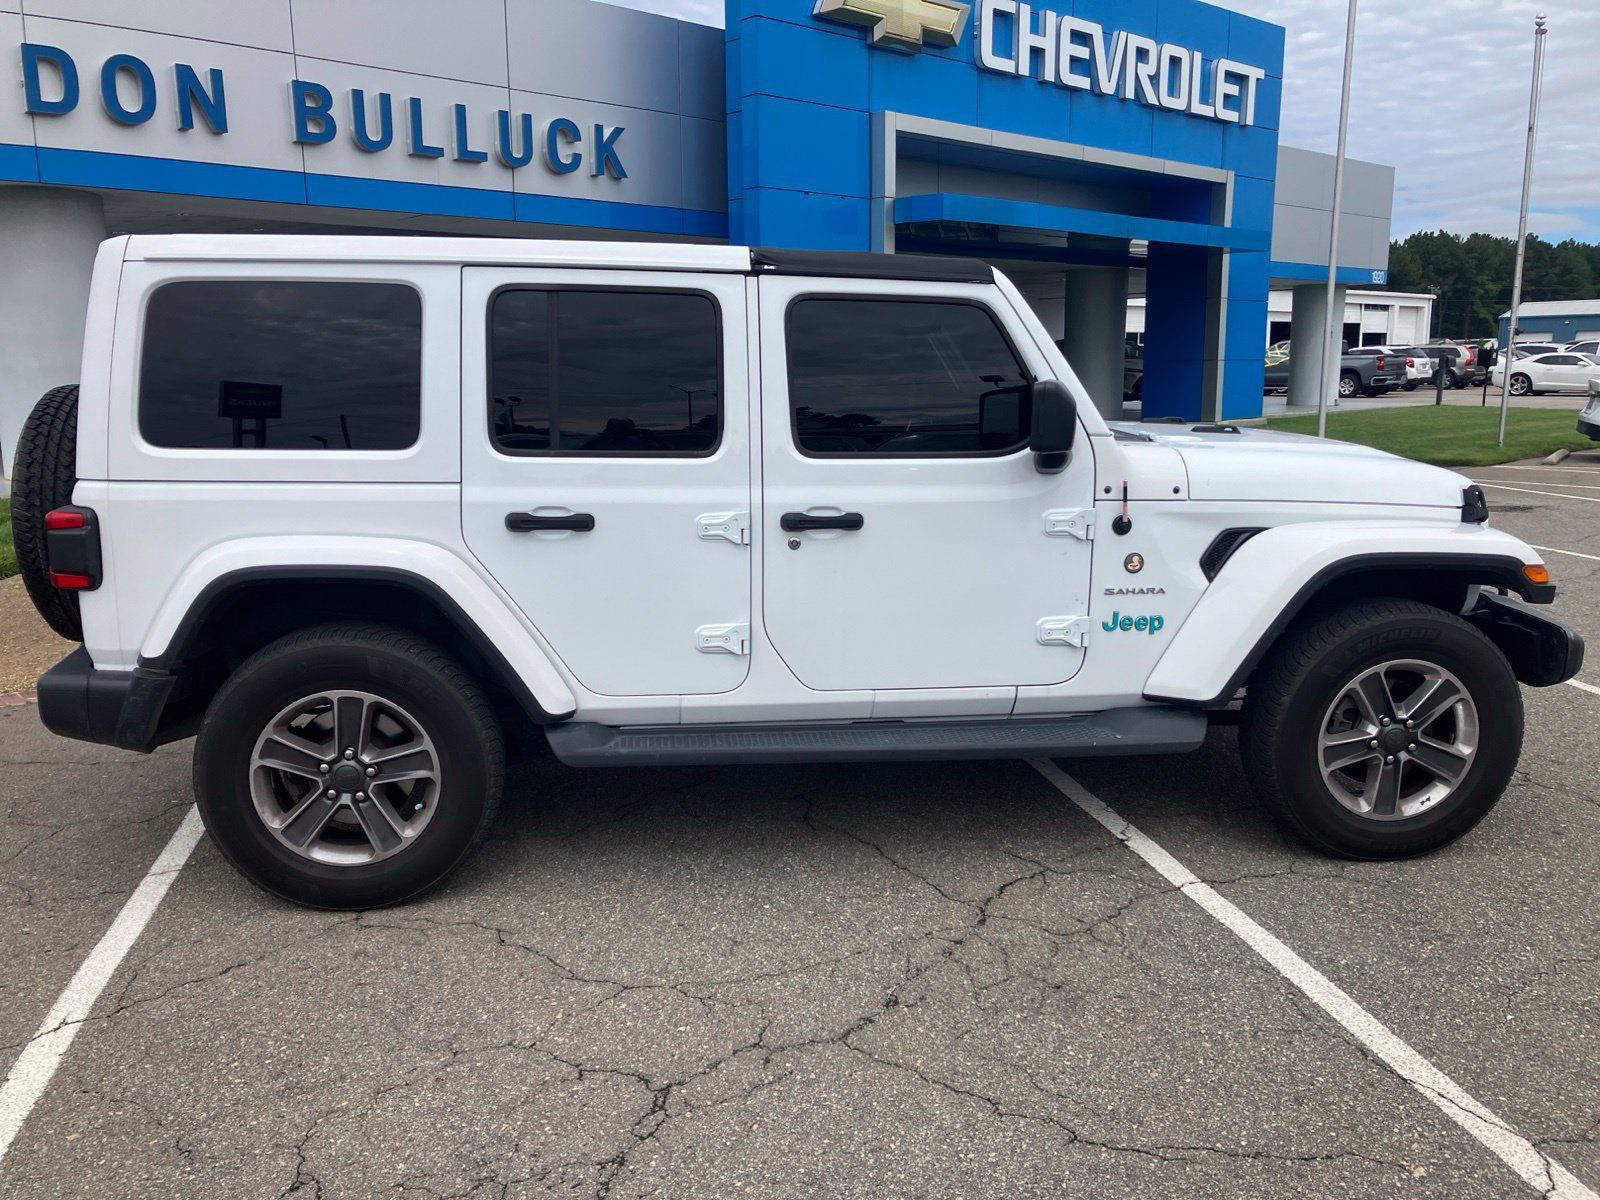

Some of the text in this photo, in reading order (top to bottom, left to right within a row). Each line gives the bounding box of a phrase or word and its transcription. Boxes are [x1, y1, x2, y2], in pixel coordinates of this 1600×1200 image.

[976, 0, 1266, 127] CHEVROLET
[21, 42, 628, 180] DON BULLUCK
[1101, 610, 1165, 635] Jeep
[1103, 587, 1166, 596] SAHARA
